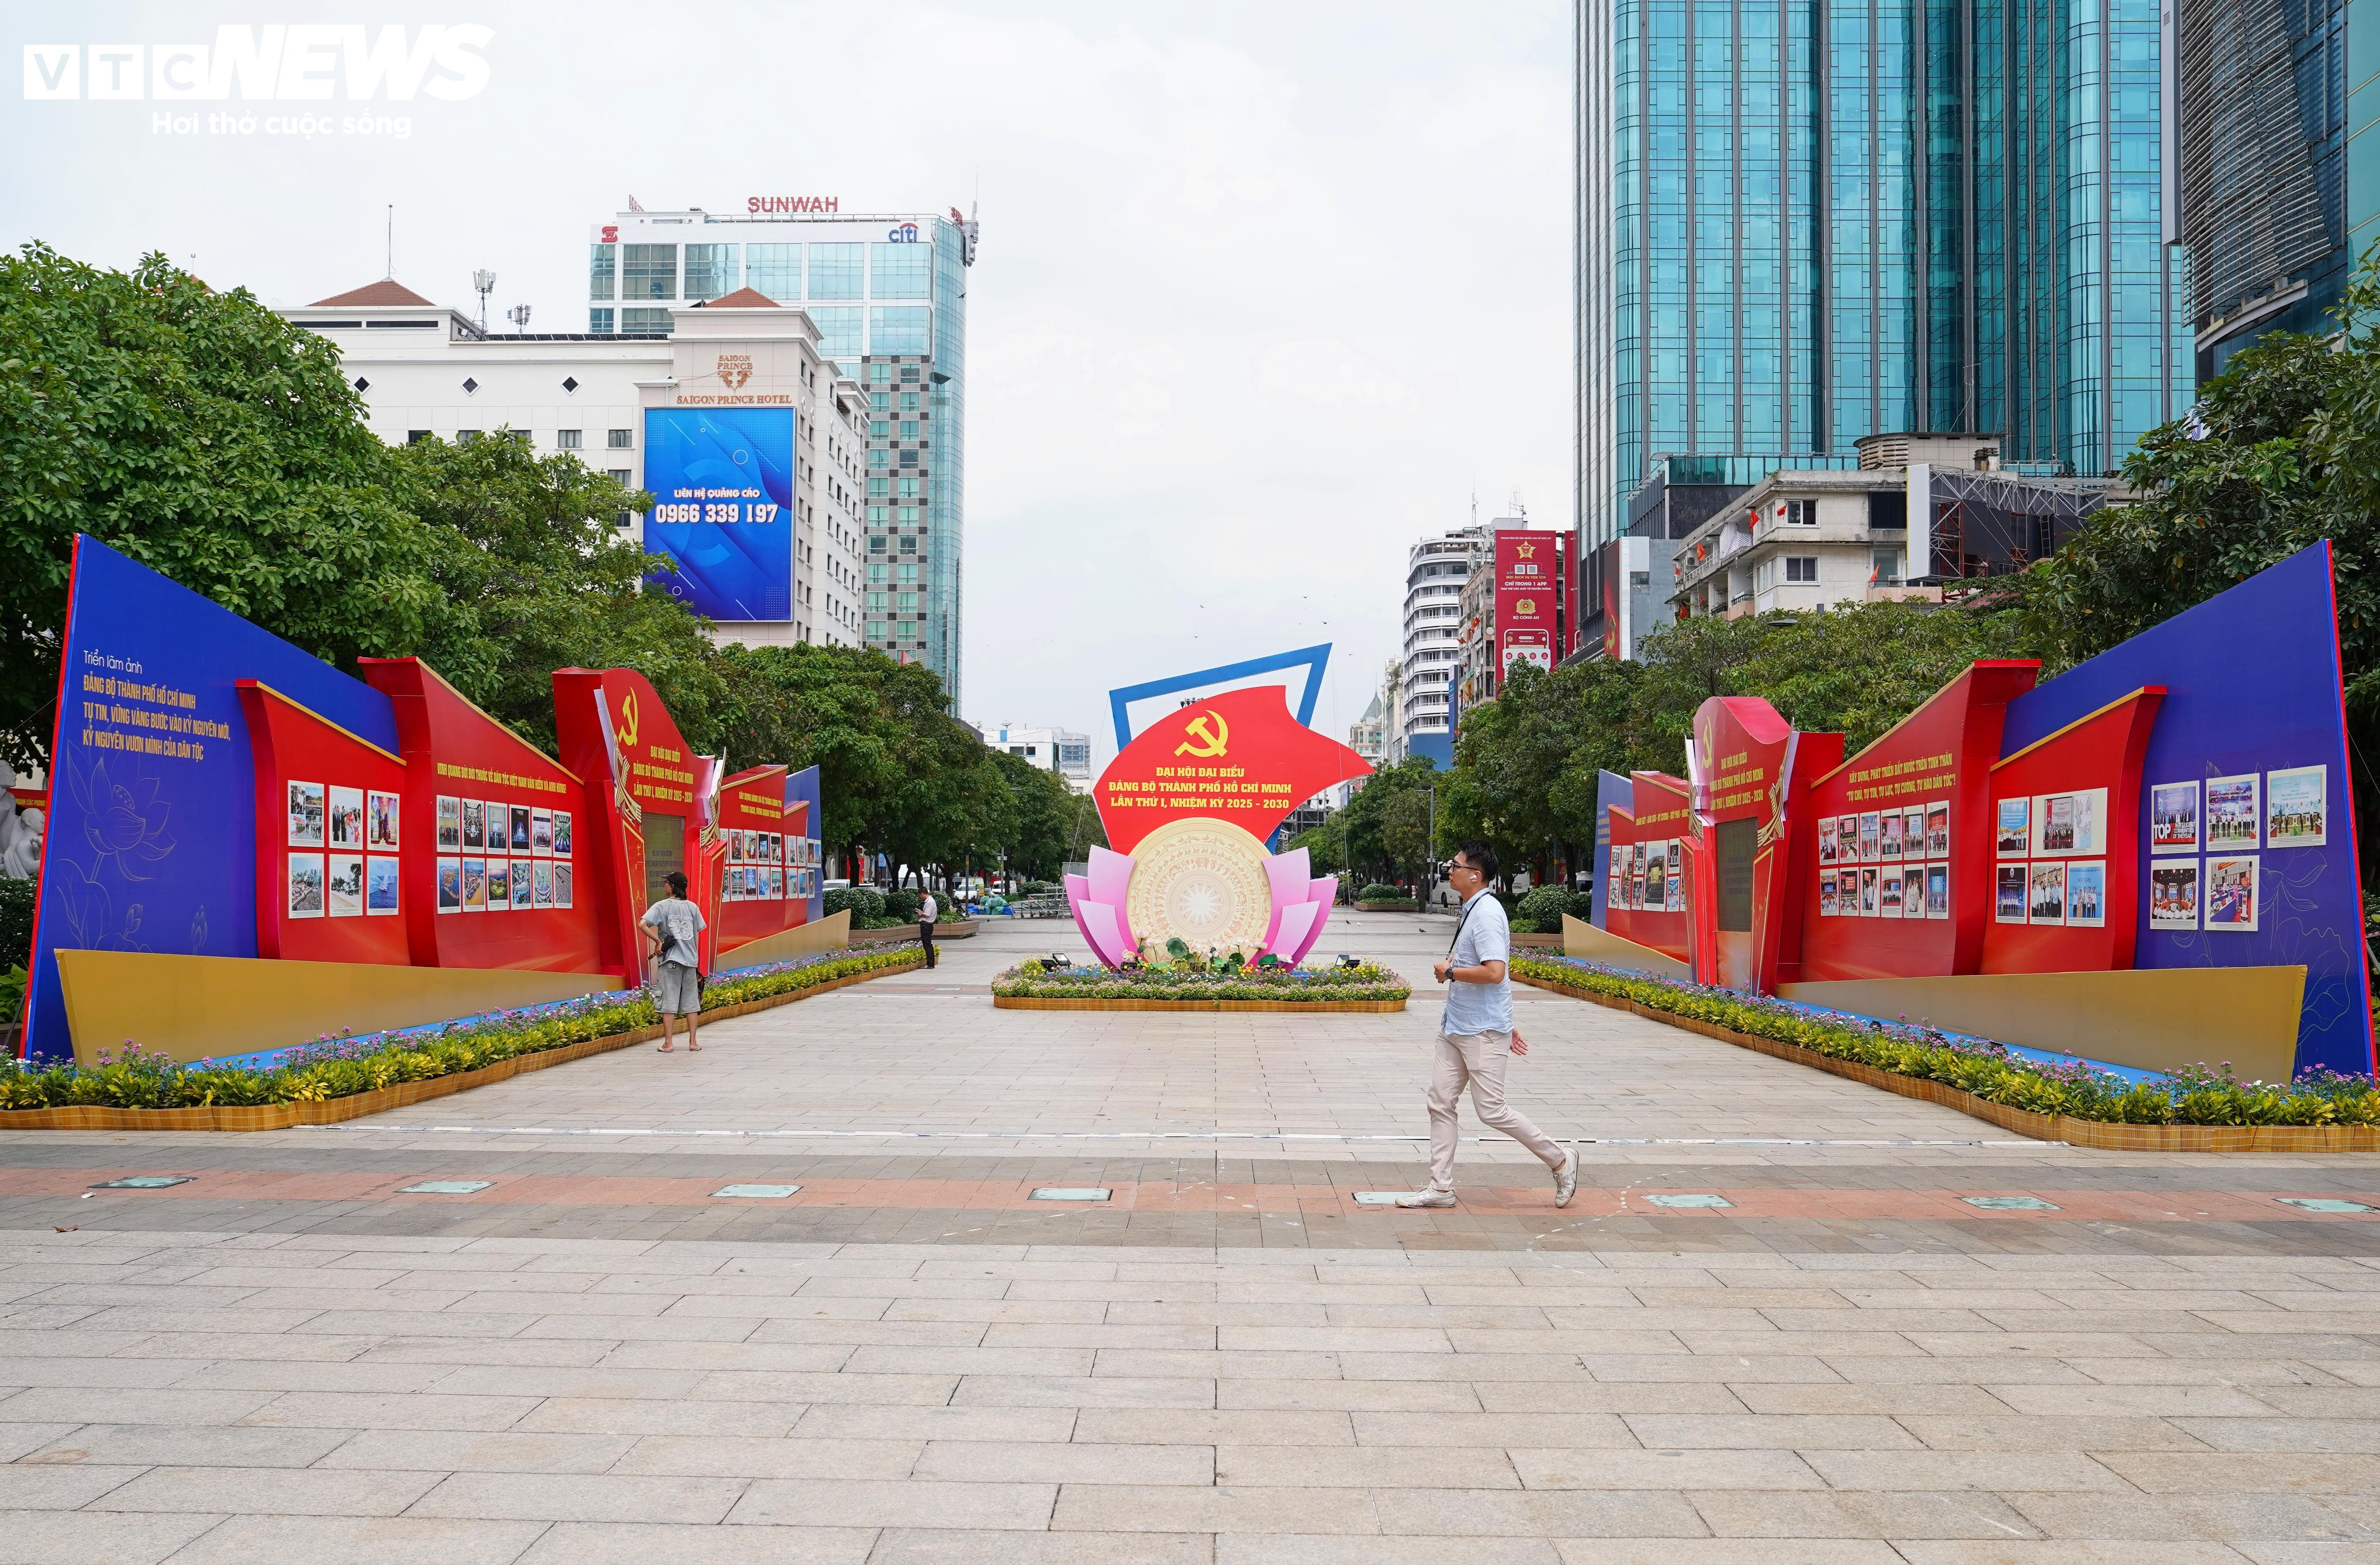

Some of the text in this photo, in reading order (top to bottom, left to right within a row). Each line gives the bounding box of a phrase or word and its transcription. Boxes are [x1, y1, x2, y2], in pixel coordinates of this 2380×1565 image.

[748, 197, 838, 213] SUNWAH
[889, 223, 918, 242] citi
[674, 487, 760, 500] LIÊN HỆ QUẢNG CÁO
[656, 504, 778, 523] 0966 339 197
[83, 649, 142, 674] Triển lãm ảnh
[84, 671, 196, 709] ĐẢNG BỘ THÀNH PHỐ HỒ CHÍ MINH
[83, 702, 230, 742] TỰ TIN, VỮNG VÀNG BƯỚC VÀO KỶ NGUYÊN MỚI,
[83, 725, 204, 763] KỶ NGUYÊN VƯƠN MÌNH CỦA DÂN TỘC
[672, 747, 680, 763] BIỂU
[1739, 747, 1747, 765] BIỂU
[633, 760, 644, 775] ĐẢNG
[646, 763, 650, 779] BỘ
[651, 765, 665, 779] THÀNH
[673, 767, 677, 782] HỒ
[684, 772, 693, 784] MINH
[1156, 764, 1244, 779] ĐẠI HỘI ĐẠI BIỂU
[1858, 770, 1870, 783] DỰNG,
[1871, 766, 1880, 779] PHÁT
[1882, 761, 1894, 777] TRIỂN
[1904, 759, 1915, 773] NƯỚC
[1916, 757, 1927, 771] TRÊN
[1928, 756, 1938, 769] TINH
[1939, 749, 1952, 767] THẦN
[437, 763, 447, 775] VINH
[448, 764, 461, 778] QUANG
[475, 768, 487, 783] THUỘC
[488, 767, 493, 780] VỀ
[544, 779, 548, 791] VÀ
[1109, 779, 1291, 794] ĐẢNG BỘ THÀNH PHỐ HỒ CHÍ MINH
[1722, 775, 1734, 789] THÀNH
[1741, 768, 1745, 784] HỒ
[1753, 768, 1764, 782] MINH
[634, 779, 693, 803] LẦN THỨ NHIỆM KỲ 2025 2030
[1855, 786, 1863, 801] CHỦ,
[1864, 788, 1869, 801] TỰ
[1879, 786, 1885, 798] TỰ
[1885, 785, 1894, 797] LỰC,
[1895, 783, 1901, 796] TỰ
[1901, 779, 1916, 793] CƯỜNG,
[1917, 779, 1923, 792] TỰ
[1923, 776, 1932, 790] HÀO
[1933, 774, 1942, 788] DÂN
[1110, 794, 1289, 809] LẦN THỨ I, NHIỆM KỲ 2025 2030
[1726, 793, 1737, 808] NHIỆM
[1737, 791, 1742, 805] KỲ
[1742, 791, 1751, 805] 2025
[1754, 789, 1763, 802] 2030
[2154, 824, 2171, 839] TOP
